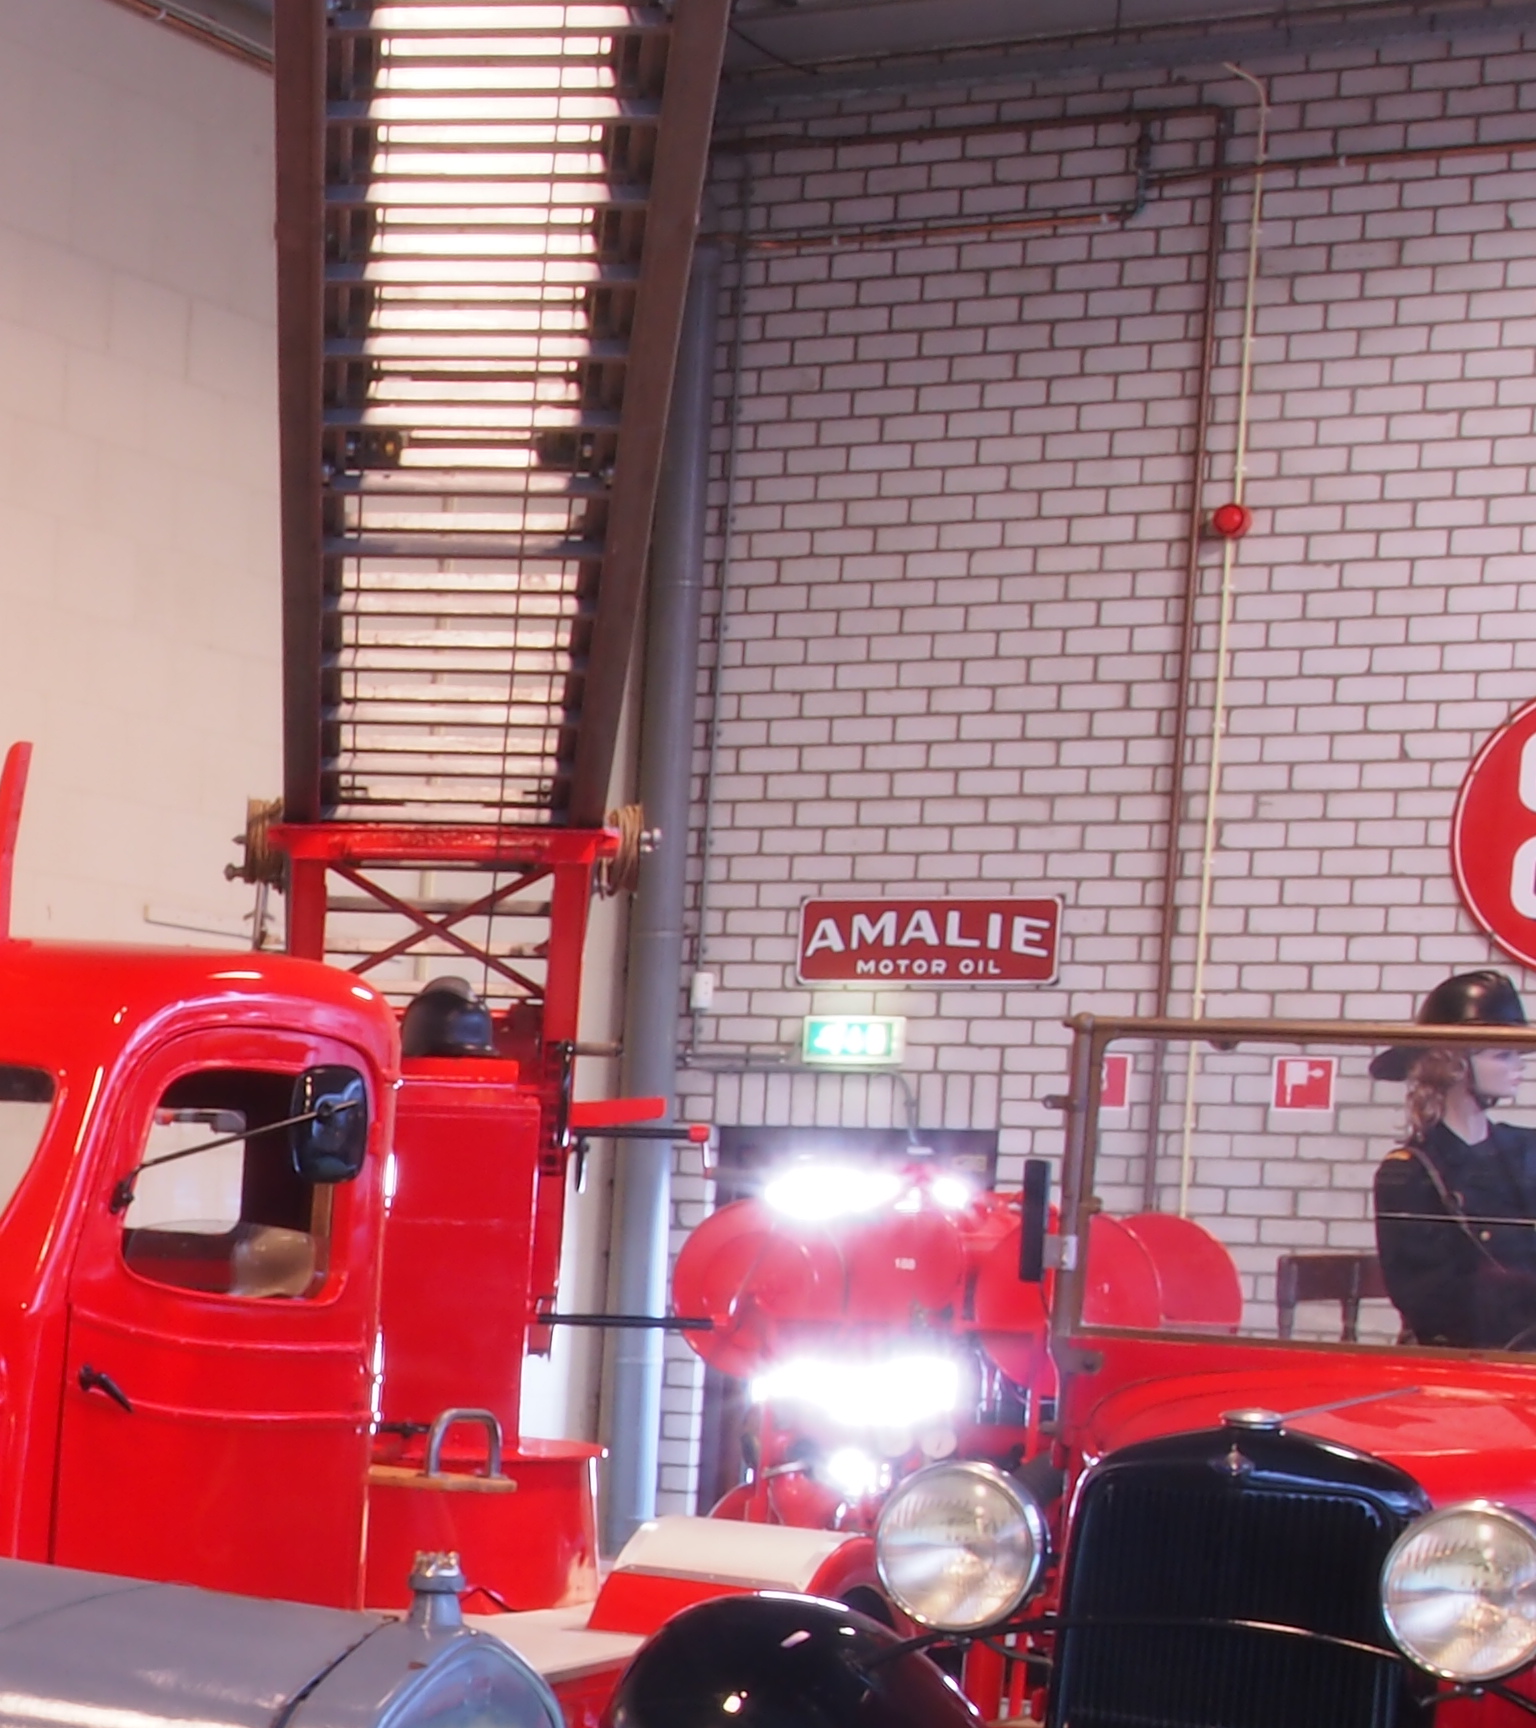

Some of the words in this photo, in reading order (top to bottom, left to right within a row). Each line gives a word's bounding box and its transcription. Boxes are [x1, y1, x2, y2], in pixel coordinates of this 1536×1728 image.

[804, 909, 1051, 957] AMALIE
[855, 959, 948, 975] MOTOR
[958, 959, 1002, 975] OIL
